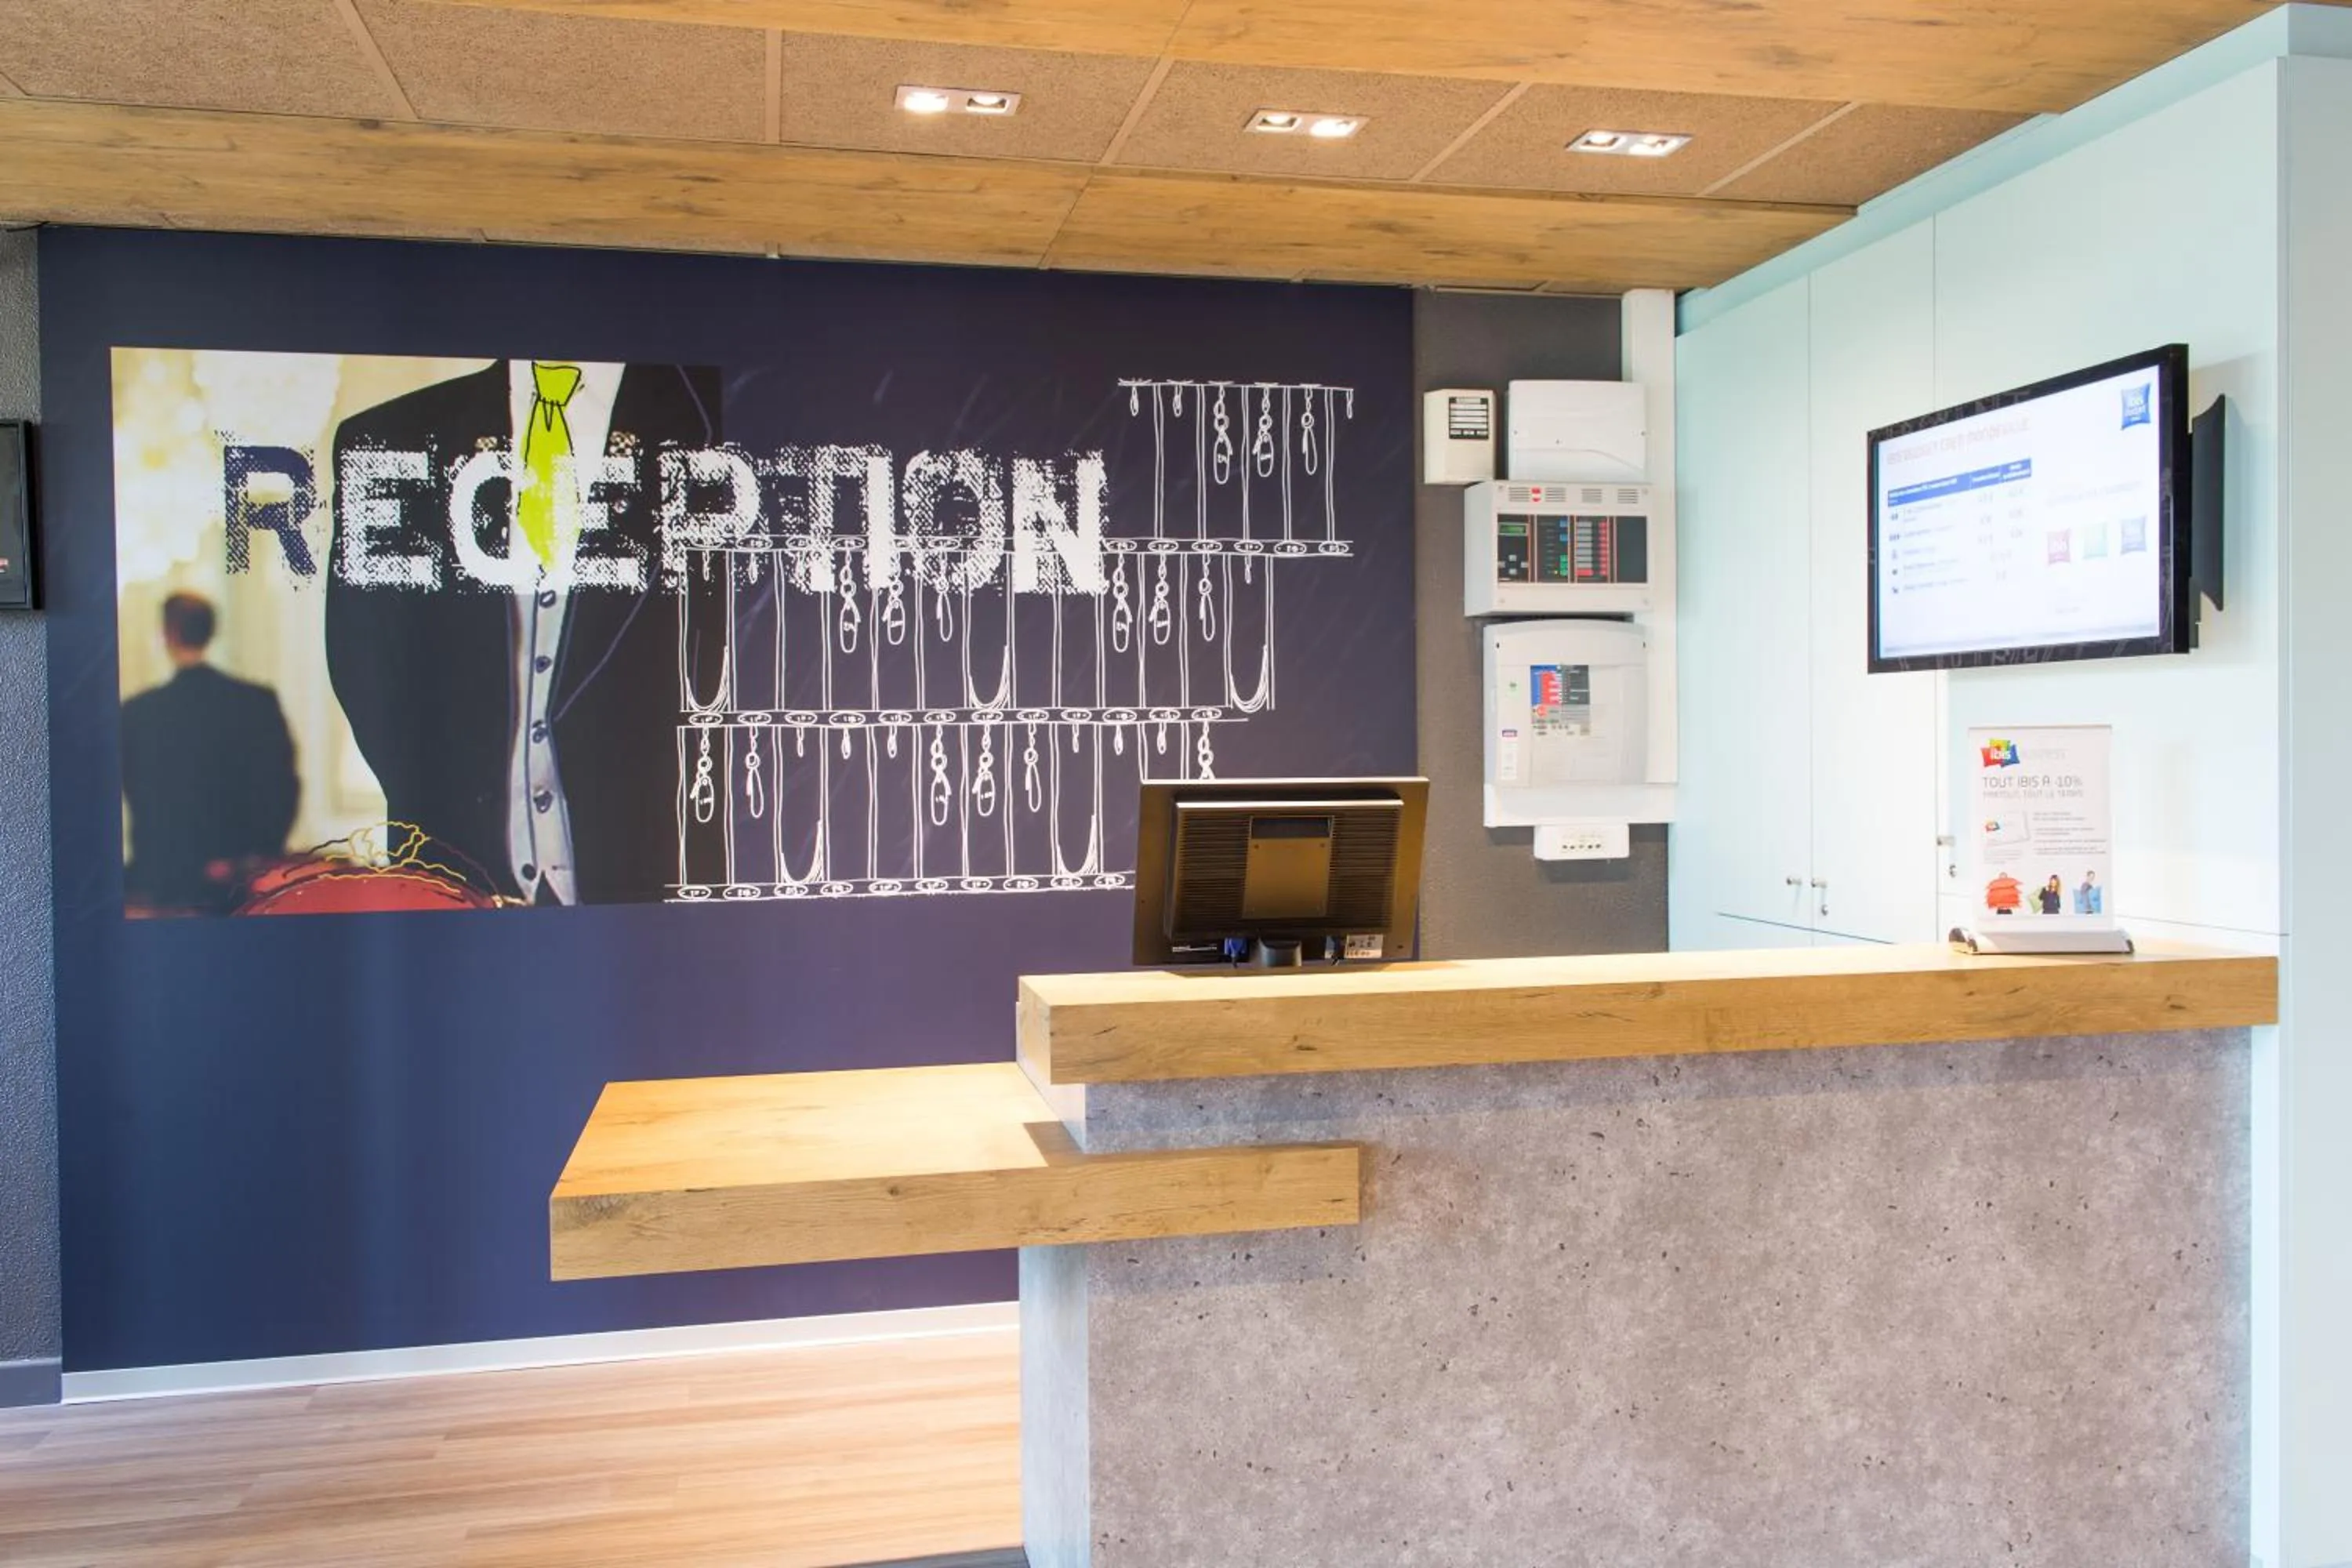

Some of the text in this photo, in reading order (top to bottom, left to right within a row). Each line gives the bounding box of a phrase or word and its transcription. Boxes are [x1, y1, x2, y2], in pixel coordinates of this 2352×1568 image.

[223, 441, 1109, 594] RECEPTION
[1982, 776, 2013, 788] TOUT
[2017, 775, 2039, 788] IBIS
